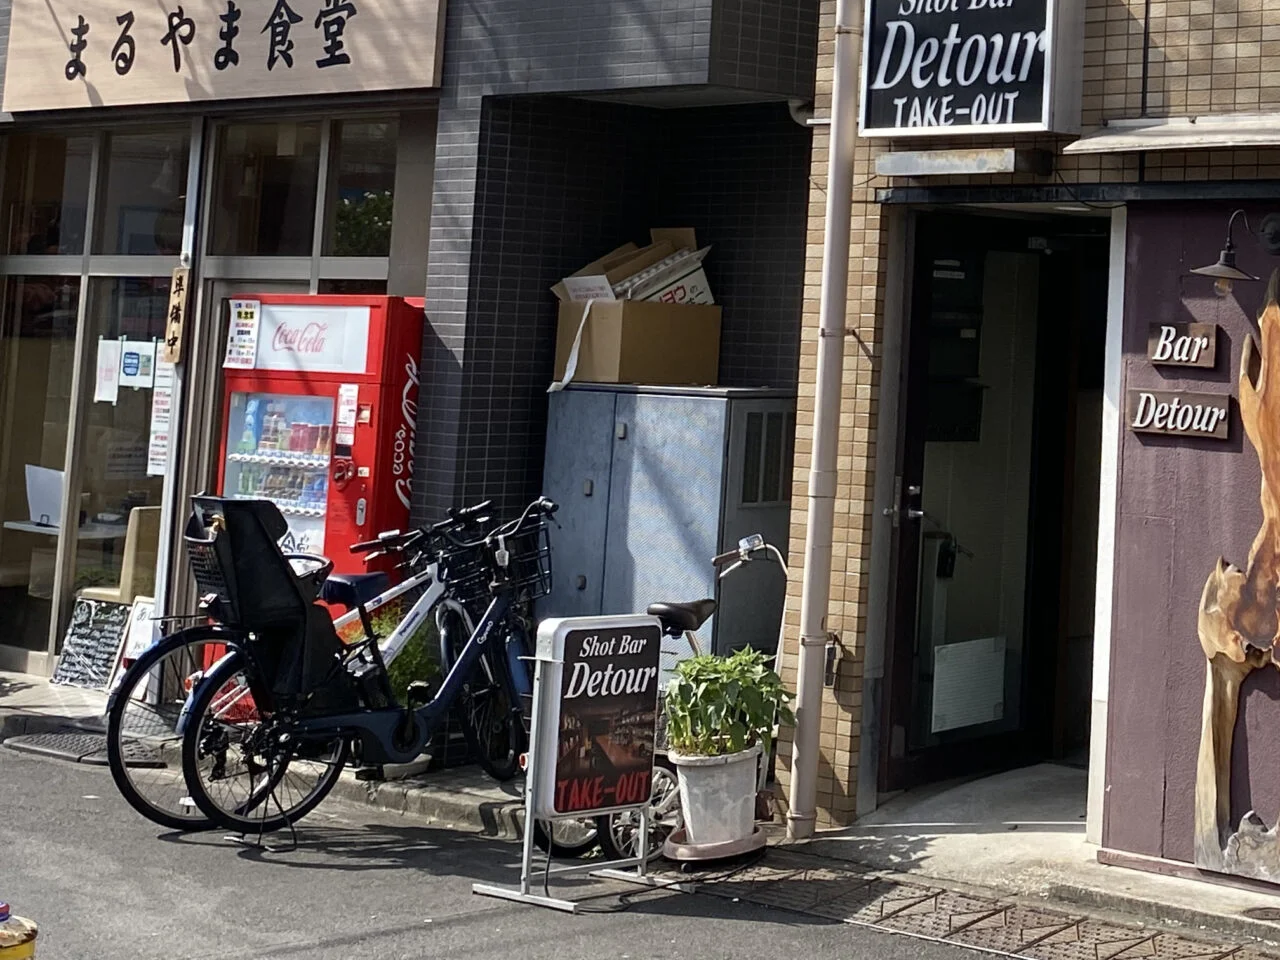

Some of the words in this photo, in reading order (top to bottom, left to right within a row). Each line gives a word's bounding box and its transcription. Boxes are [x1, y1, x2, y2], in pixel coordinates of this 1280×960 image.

[869, 20, 1047, 90] Detour
[893, 91, 1019, 128] TAKE-OUT
[1152, 326, 1208, 362] Bar
[1132, 393, 1226, 432] Detour
[579, 635, 617, 658] Shot
[618, 634, 647, 655] Bar
[563, 661, 657, 700] Detour
[557, 771, 650, 812] TAKE-OUT
